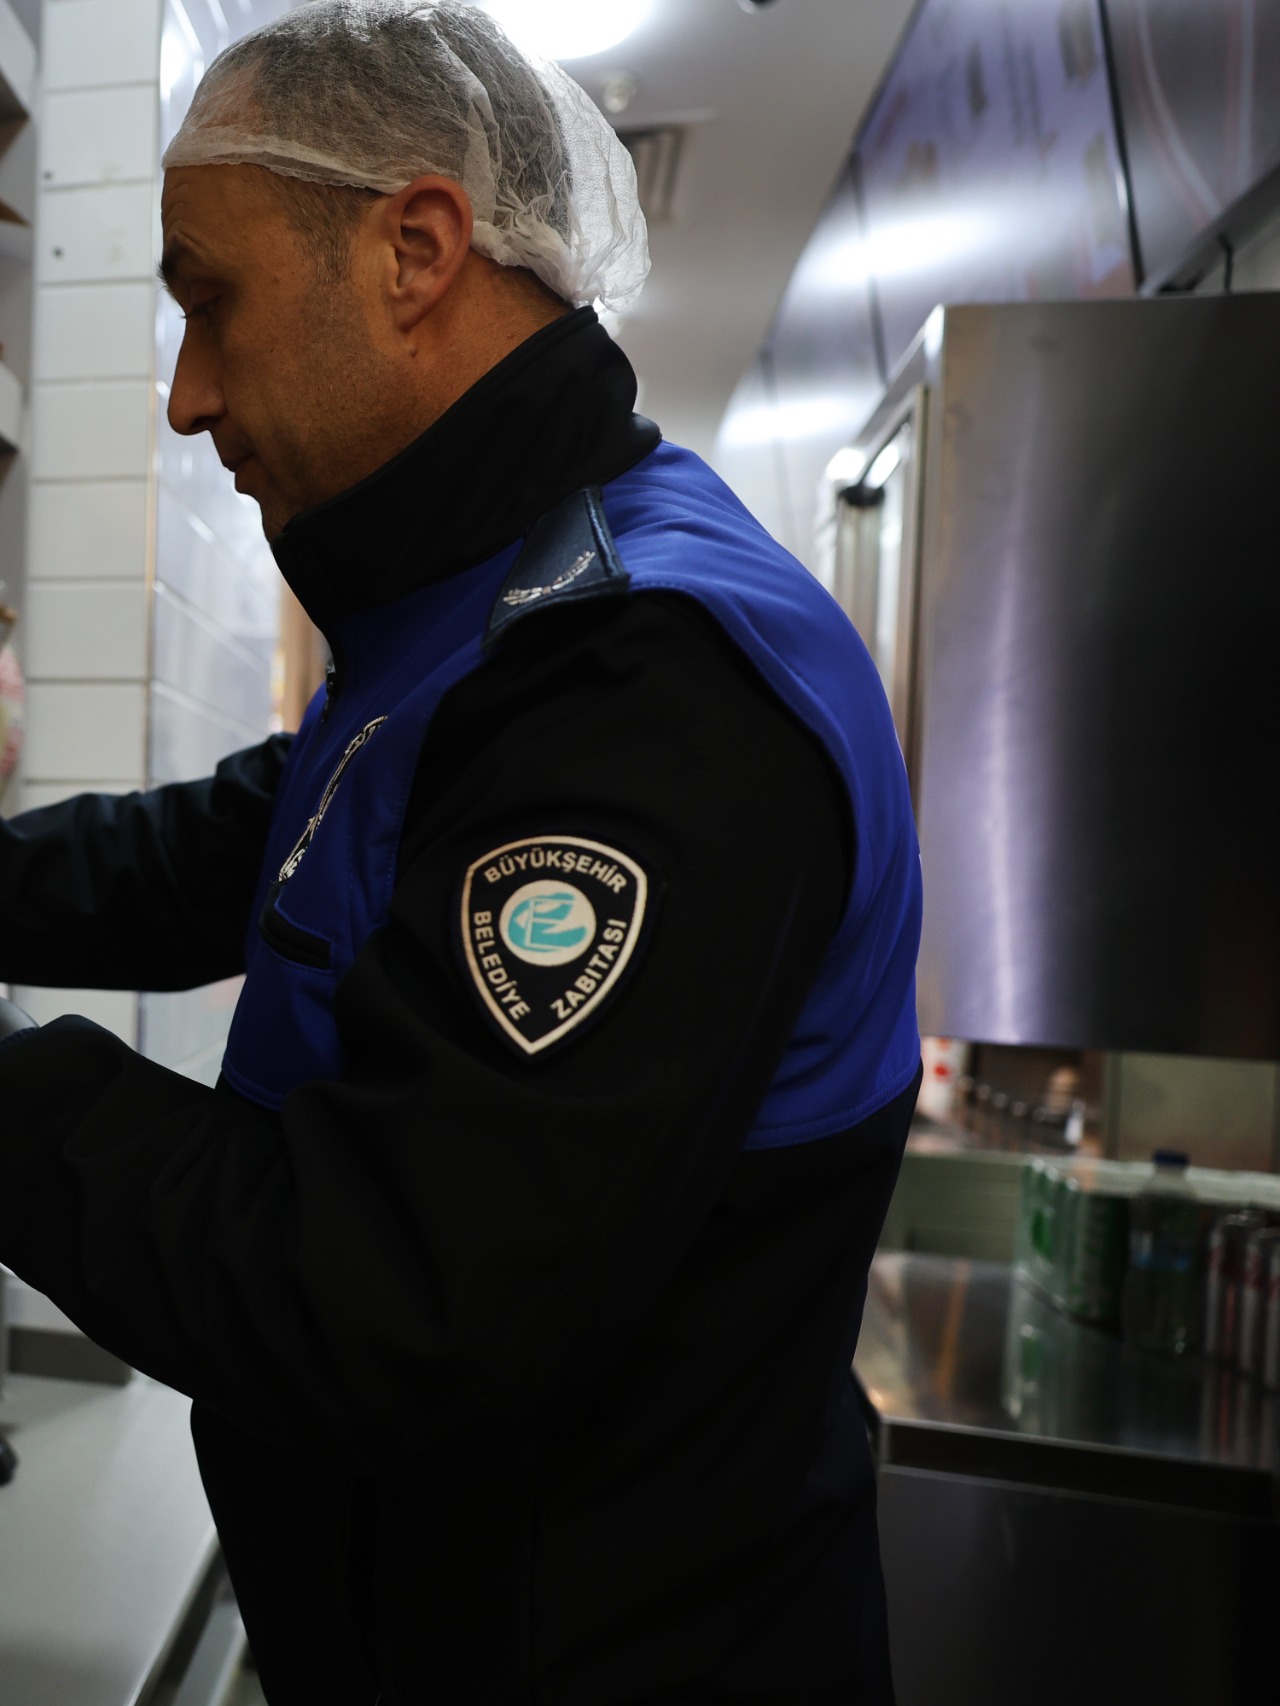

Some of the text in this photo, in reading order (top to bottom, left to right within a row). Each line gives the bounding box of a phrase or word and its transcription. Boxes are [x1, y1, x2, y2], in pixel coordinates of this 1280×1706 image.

[483, 847, 628, 895] BÜYÜKŞEHİR
[473, 910, 532, 1021] BELEDİYE
[549, 918, 628, 1021] ZABITASI
